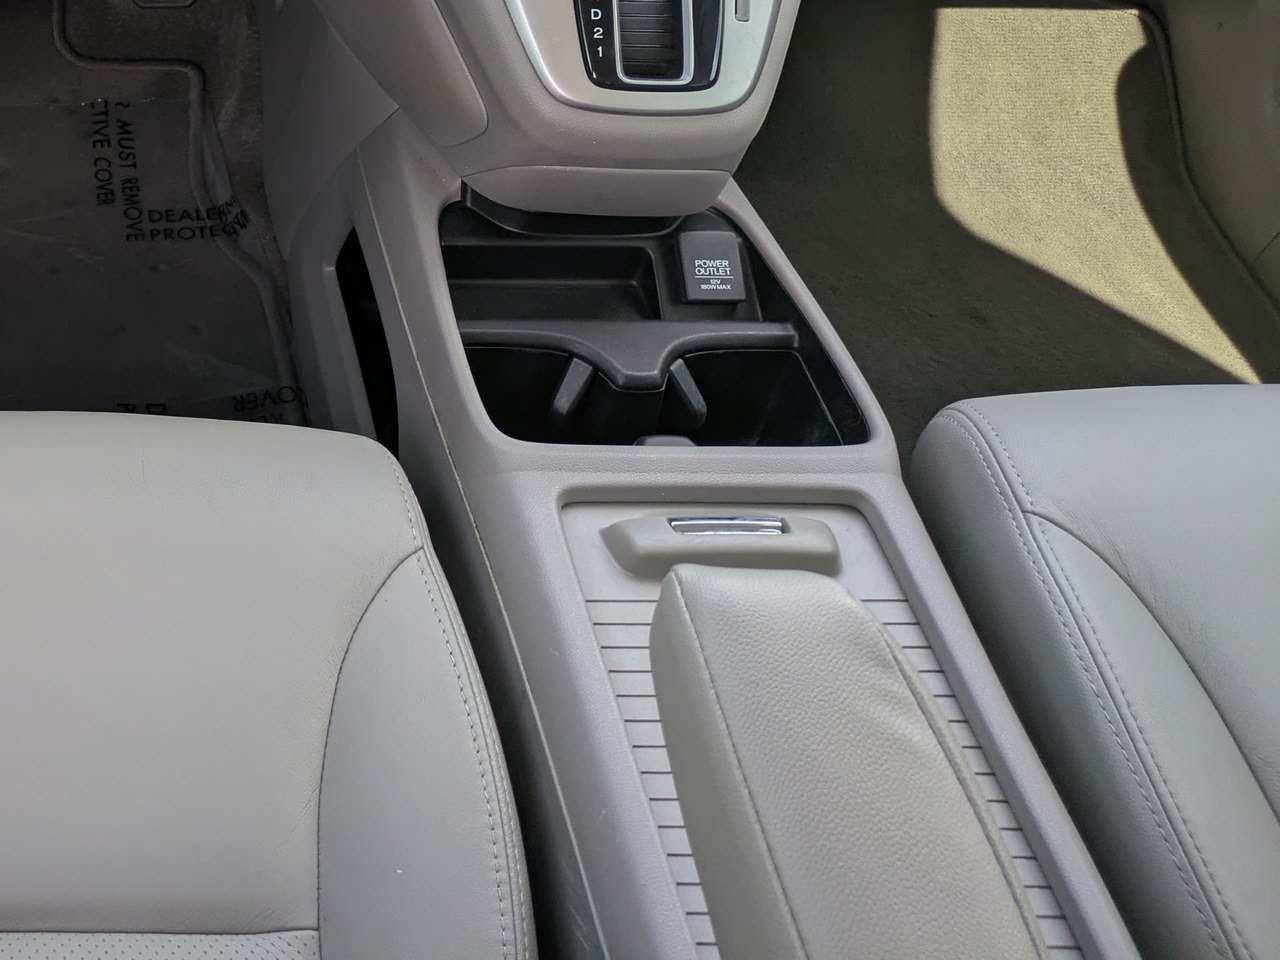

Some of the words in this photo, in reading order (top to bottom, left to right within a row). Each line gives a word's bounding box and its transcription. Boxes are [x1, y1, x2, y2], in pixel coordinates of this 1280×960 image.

[591, 9, 602, 20] D
[593, 27, 604, 39] 2
[597, 46, 603, 57] 1
[117, 119, 136, 169] MUST
[94, 157, 114, 208] COVER
[121, 175, 145, 241] REMOVE
[694, 259, 729, 268] POWER
[695, 267, 731, 276] OUTLET
